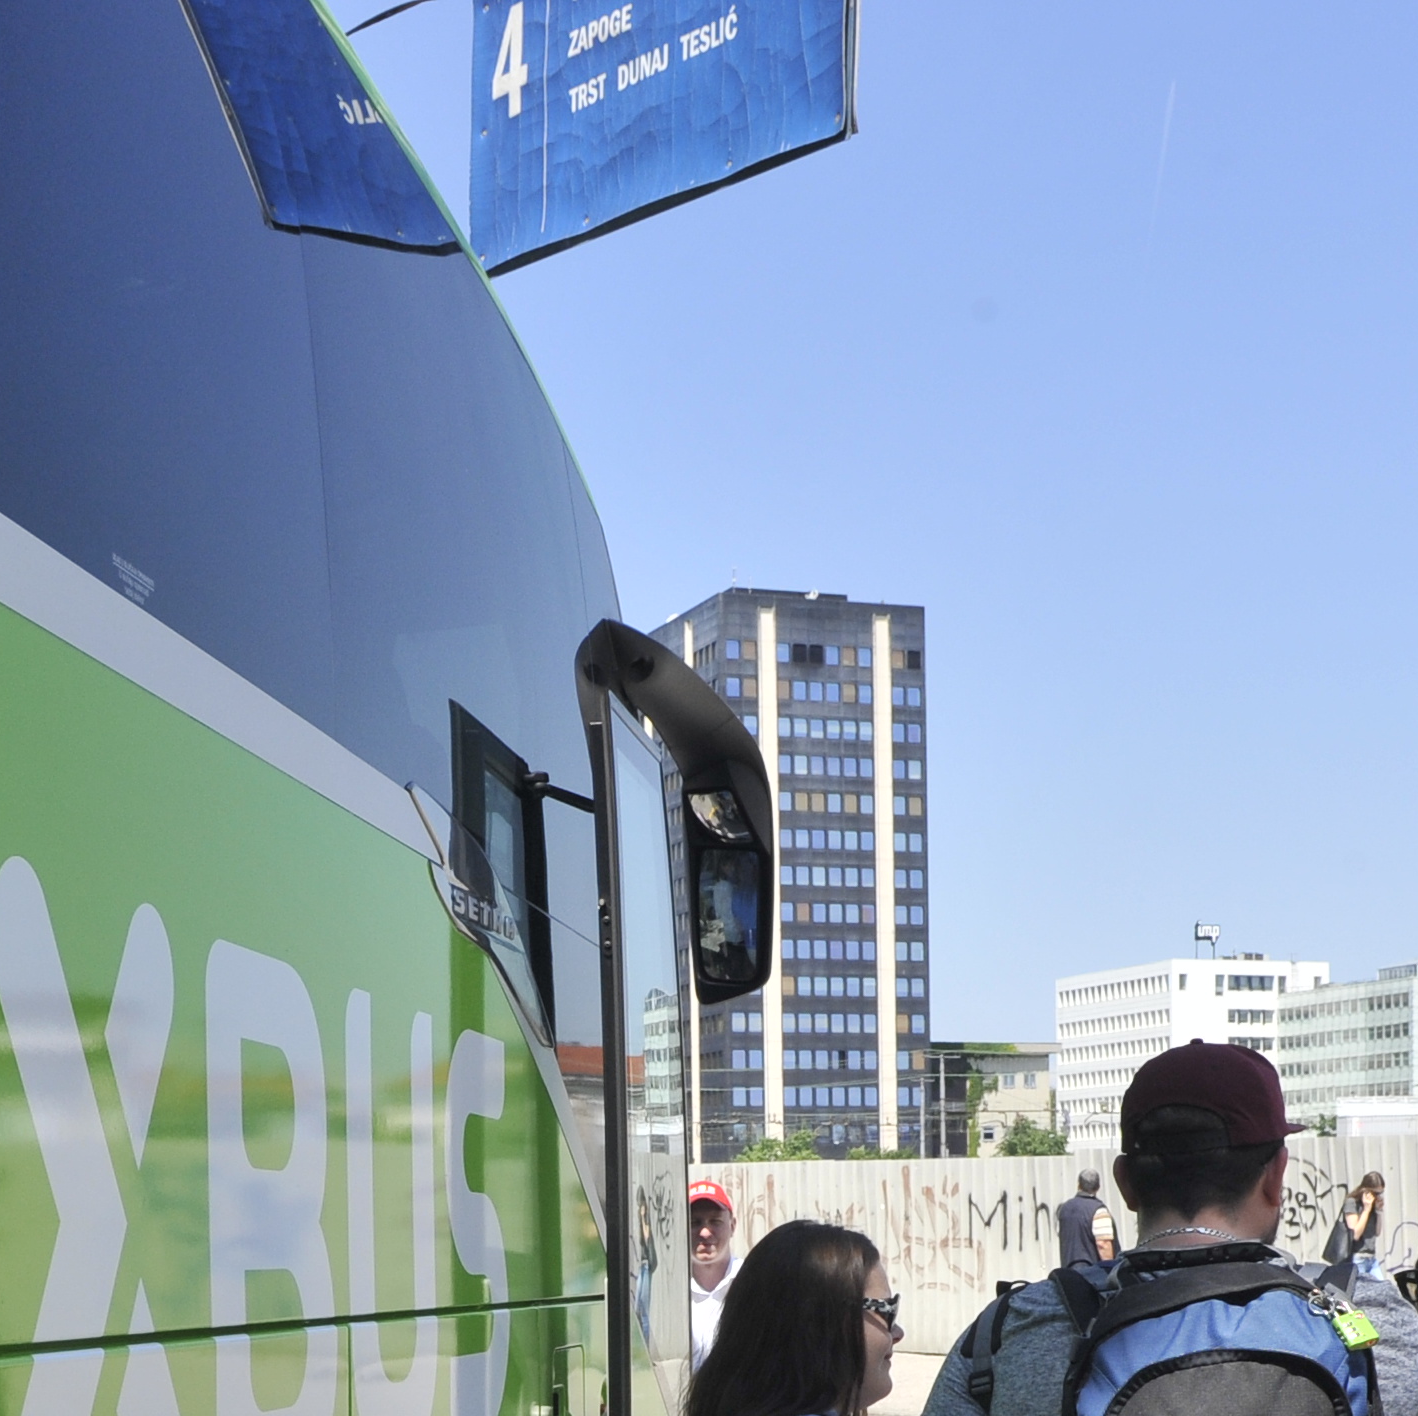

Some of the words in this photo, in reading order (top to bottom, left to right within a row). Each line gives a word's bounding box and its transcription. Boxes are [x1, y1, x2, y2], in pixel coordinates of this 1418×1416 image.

[492, 1, 528, 119] 4
[567, 4, 633, 58] ZAPOGE
[569, 73, 607, 113] TRST
[617, 43, 669, 92] DUNAJ
[680, 5, 738, 61] TESLIĆ
[969, 1186, 1060, 1251] Mih
